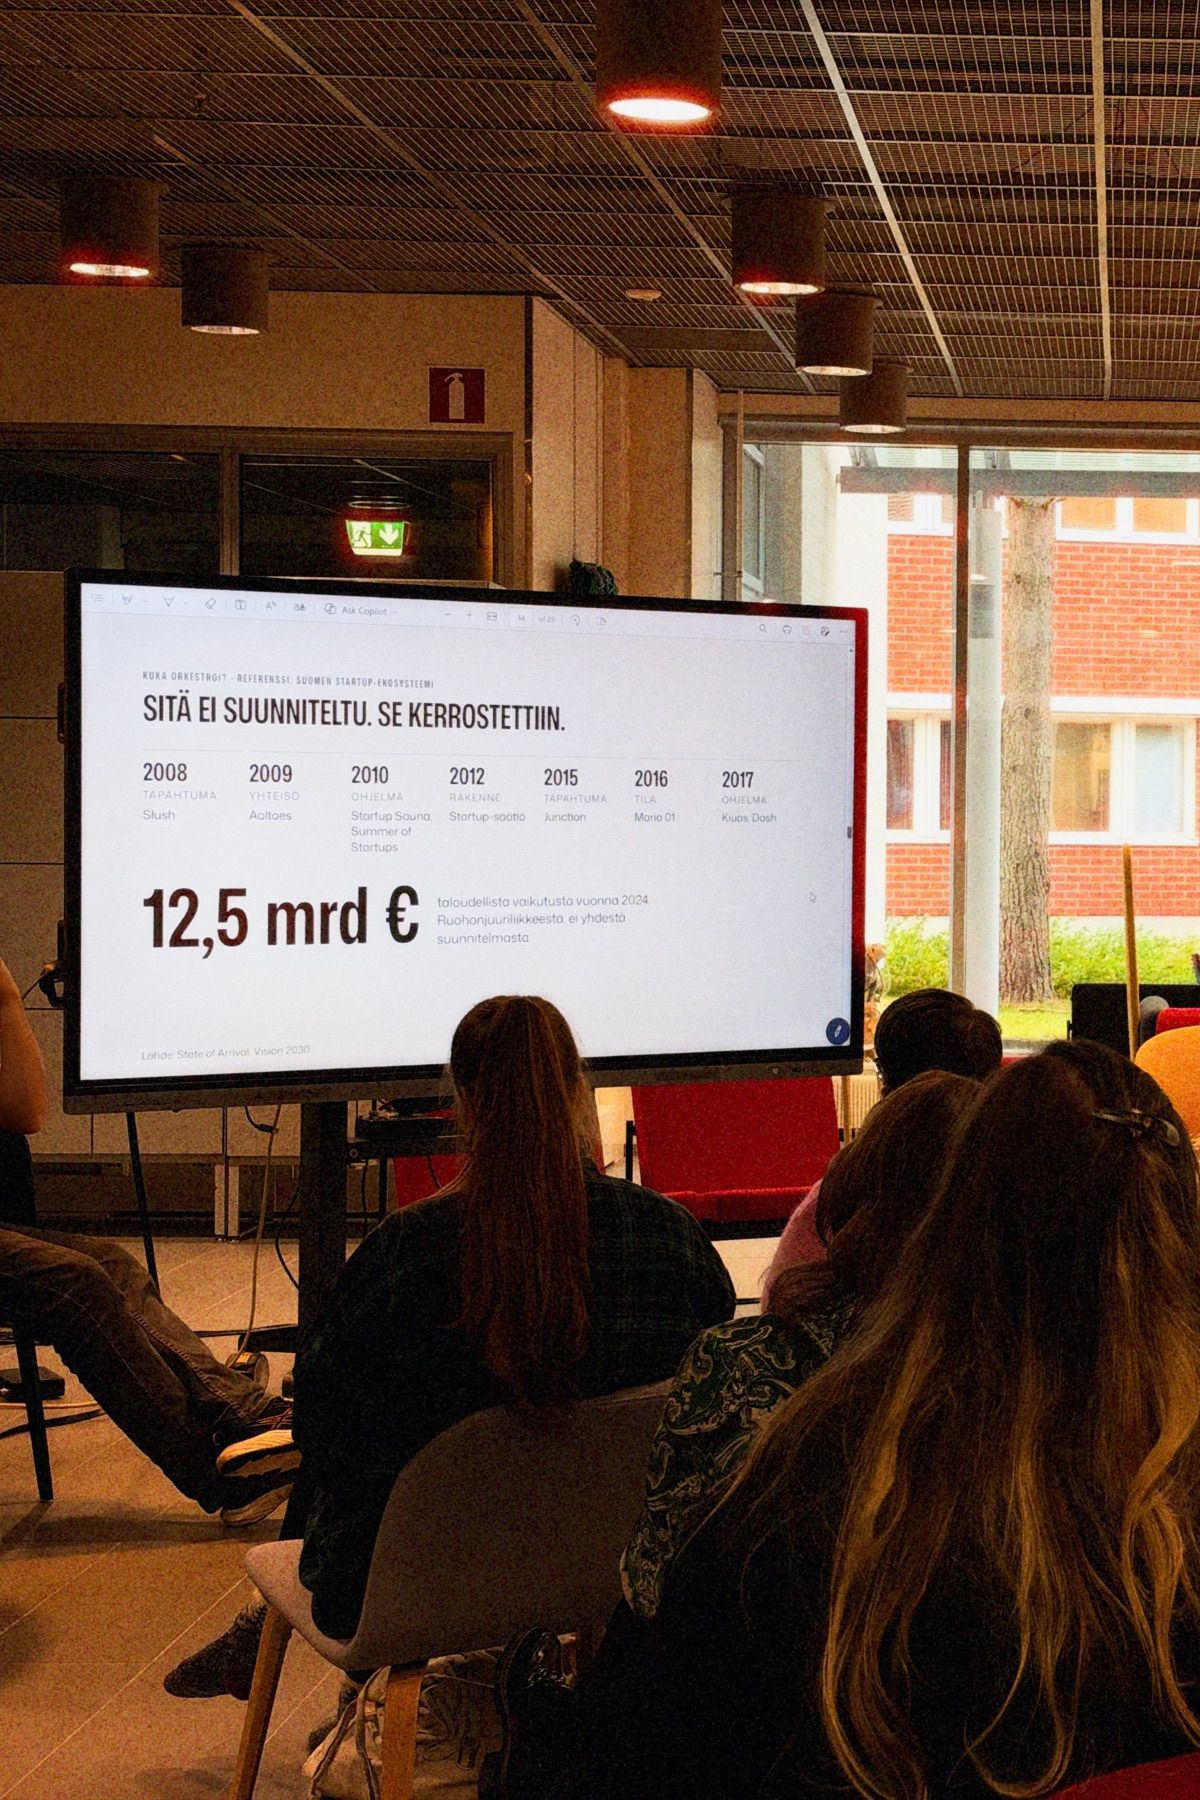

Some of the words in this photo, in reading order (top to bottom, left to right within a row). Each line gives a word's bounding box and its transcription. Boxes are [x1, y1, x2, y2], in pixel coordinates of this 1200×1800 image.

[342, 606, 355, 614] Ask
[358, 606, 387, 617] Copilot
[142, 671, 167, 681] KUKA
[171, 672, 227, 682] ORKESTROI?
[296, 676, 332, 686] SUOMEN
[336, 677, 434, 689] STARTUP-EKOSYSTEEMI
[143, 689, 192, 723] SITÄ
[199, 696, 216, 723] EI
[224, 696, 372, 727] SUUNNITELTU.
[378, 701, 403, 728] SE
[409, 702, 566, 731] KERROSTETTIIN.
[143, 762, 188, 782] 2008
[250, 764, 293, 783] 2009
[352, 766, 389, 784] 2010
[450, 766, 485, 785] 2012
[544, 768, 579, 786] 2015
[635, 770, 668, 788] 2016
[722, 771, 755, 789] 2017
[143, 790, 217, 800] TAPAHTUMA
[352, 792, 404, 802] OHJELMA
[450, 793, 501, 803] RAKENNE
[544, 794, 608, 804] TAPAHTUMA
[634, 794, 657, 804] TILA
[722, 796, 768, 805] OHJELMA
[142, 809, 176, 821] Slush
[250, 810, 292, 821] Aaltoes
[351, 810, 393, 823] Startup
[395, 810, 433, 822] Sauna,
[544, 812, 587, 823] Junction
[634, 812, 663, 823] Maria
[664, 812, 676, 822] 01
[752, 812, 777, 823] Dash
[351, 826, 398, 837] Summer
[400, 826, 412, 837] of
[351, 842, 399, 854] Startups
[437, 896, 510, 908] taloudellista
[512, 896, 574, 907] vaikutusta
[576, 896, 619, 907] vuonna
[621, 894, 649, 906] 2024
[143, 887, 249, 960] 12,5
[267, 886, 368, 947] mrd
[385, 884, 420, 944] €
[568, 914, 579, 924] ei
[176, 1048, 204, 1060] State
[206, 1048, 215, 1058] of
[254, 1046, 284, 1056] Vision
[286, 1044, 310, 1055] 2030
